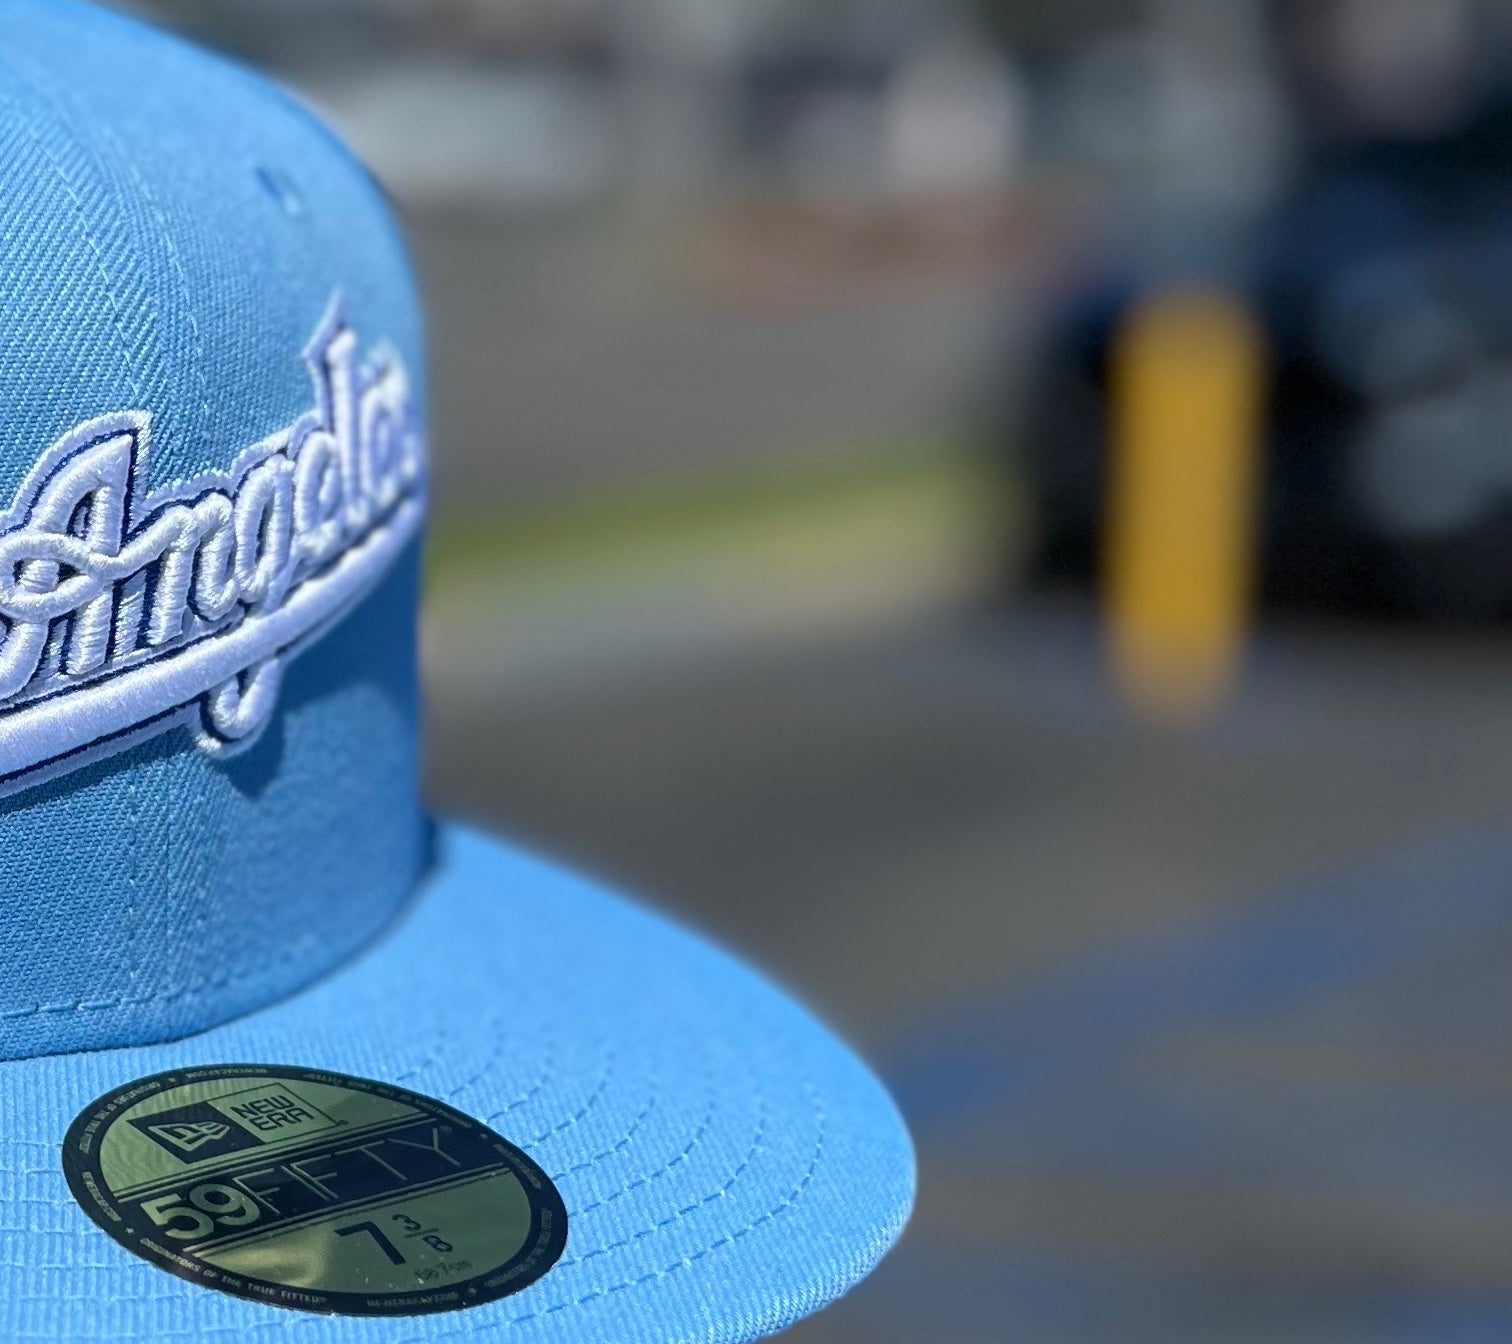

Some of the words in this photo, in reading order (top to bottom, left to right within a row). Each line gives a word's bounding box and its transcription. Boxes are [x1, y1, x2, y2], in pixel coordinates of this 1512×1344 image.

[230, 1094, 296, 1119] NEW
[248, 1106, 316, 1132] ERA
[140, 1125, 461, 1240] 59FIFTY
[333, 1220, 407, 1266] 7
[391, 1213, 454, 1253] 3/8
